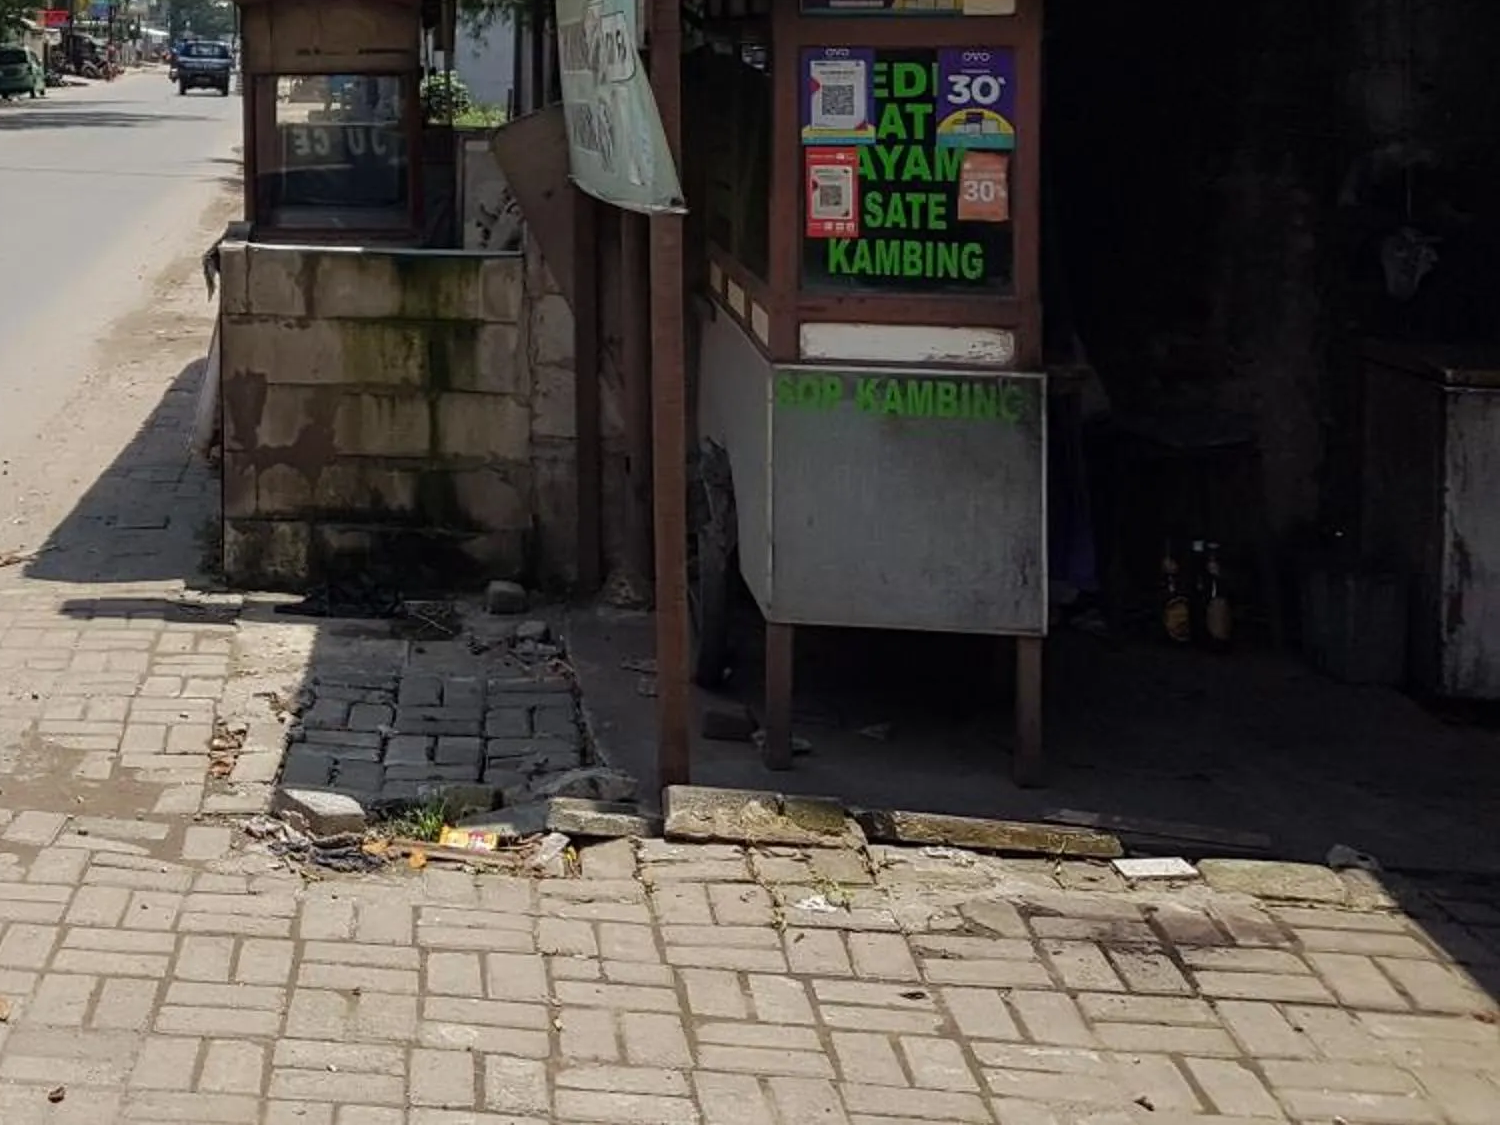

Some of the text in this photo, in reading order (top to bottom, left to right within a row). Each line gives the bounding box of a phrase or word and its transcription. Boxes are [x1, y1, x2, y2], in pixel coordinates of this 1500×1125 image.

[873, 62, 939, 99] EDI
[877, 103, 933, 141] AT
[855, 145, 965, 183] AYAM
[863, 191, 947, 230] SATE
[828, 238, 985, 280] KAMBING
[854, 377, 1023, 422] KAMBING
